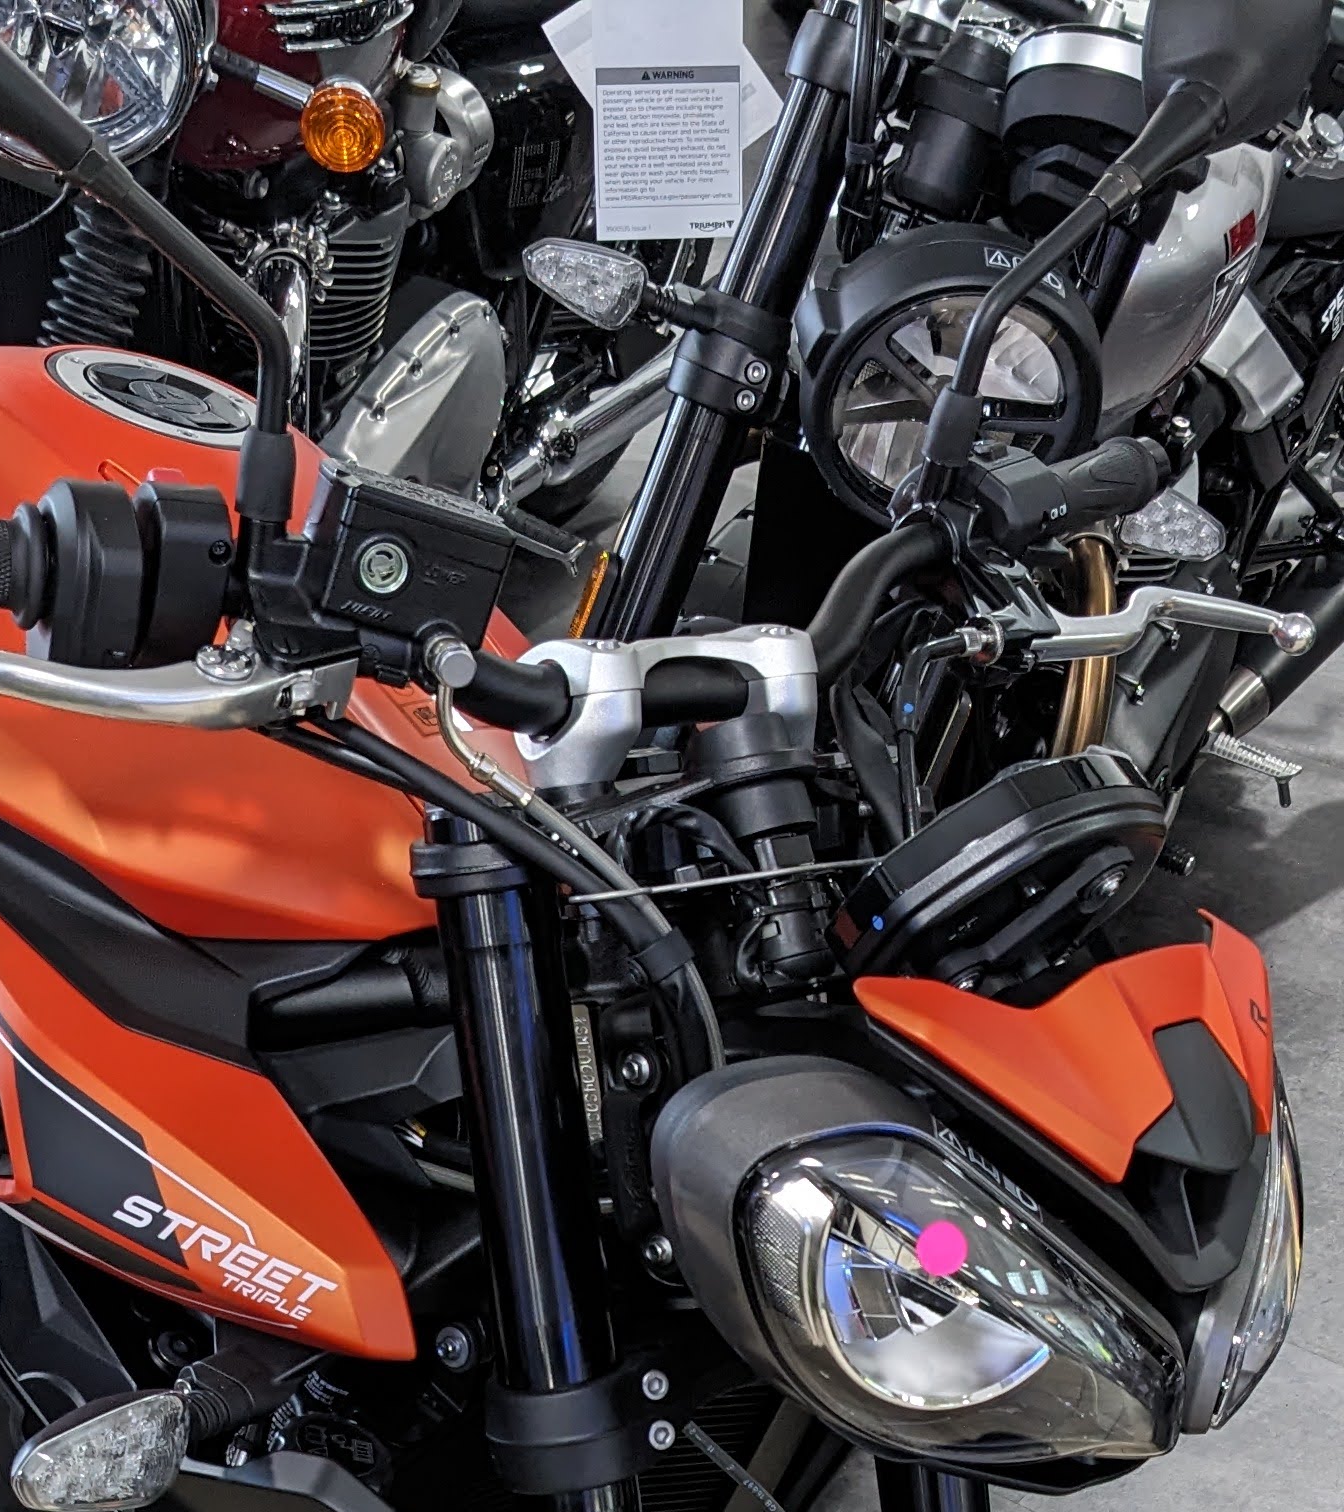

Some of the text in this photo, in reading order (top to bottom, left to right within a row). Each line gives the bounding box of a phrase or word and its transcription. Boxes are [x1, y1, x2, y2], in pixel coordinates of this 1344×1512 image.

[653, 70, 694, 79] WARNING
[676, 104, 702, 112] including
[629, 137, 665, 145] reproductive
[651, 145, 679, 153] breathing
[627, 154, 647, 162] engine
[621, 170, 639, 178] gloves
[622, 178, 648, 186] servicing
[690, 222, 725, 230] TRIUMPH
[112, 1194, 339, 1304] STREET
[222, 1273, 313, 1322] TRIPLE
